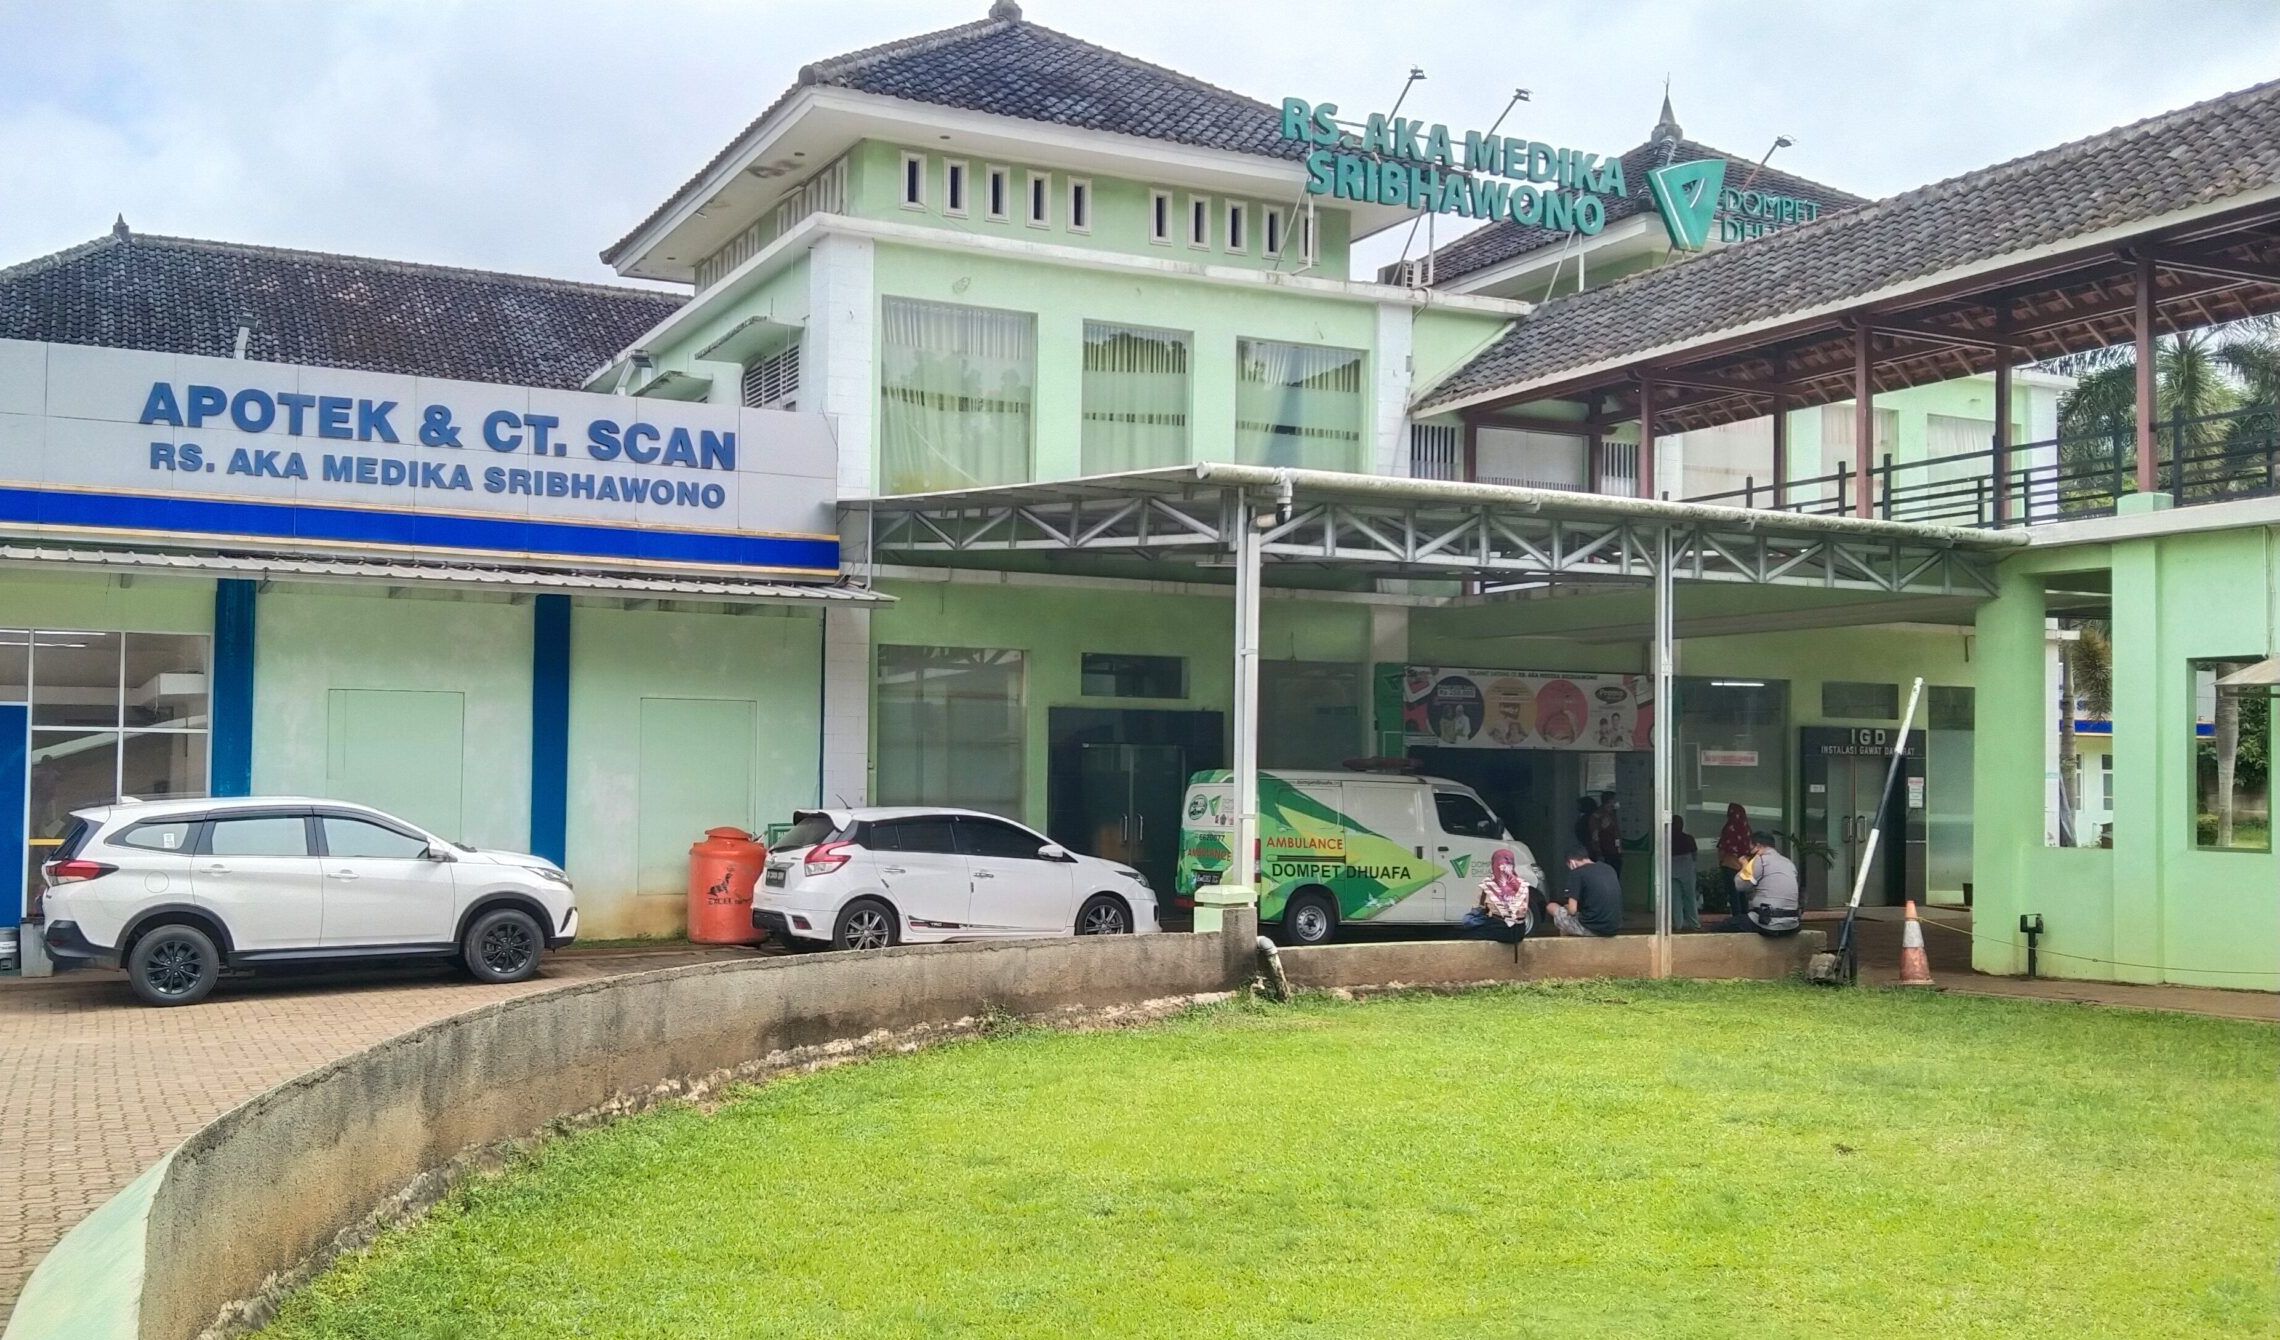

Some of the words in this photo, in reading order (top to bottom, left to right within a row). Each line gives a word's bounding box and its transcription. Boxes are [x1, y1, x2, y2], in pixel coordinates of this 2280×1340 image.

[1282, 97, 1357, 149] RS.
[1361, 112, 1454, 166] AKA
[1464, 129, 1628, 198] MEDIKA
[1306, 152, 1606, 236] SRIBHAWONO
[1724, 187, 1822, 225] DOMPET
[139, 382, 400, 443] APOTEK
[419, 403, 464, 448] &
[483, 410, 567, 457] CT.
[587, 419, 736, 471] SCAN
[150, 442, 215, 473] RS.
[227, 448, 309, 480] AKA
[322, 454, 473, 491] MEDIKA
[484, 466, 726, 509] SRIBHAWONO
[1821, 745, 1857, 755] INSTALASI
[1859, 746, 1882, 755] GAWAT
[1884, 747, 1915, 756] DARAT
[1851, 728, 1886, 745] IGD
[1266, 836, 1344, 850] AMBULANCE
[1272, 863, 1341, 878] DOMPET
[1346, 865, 1411, 880] DHUAFA
